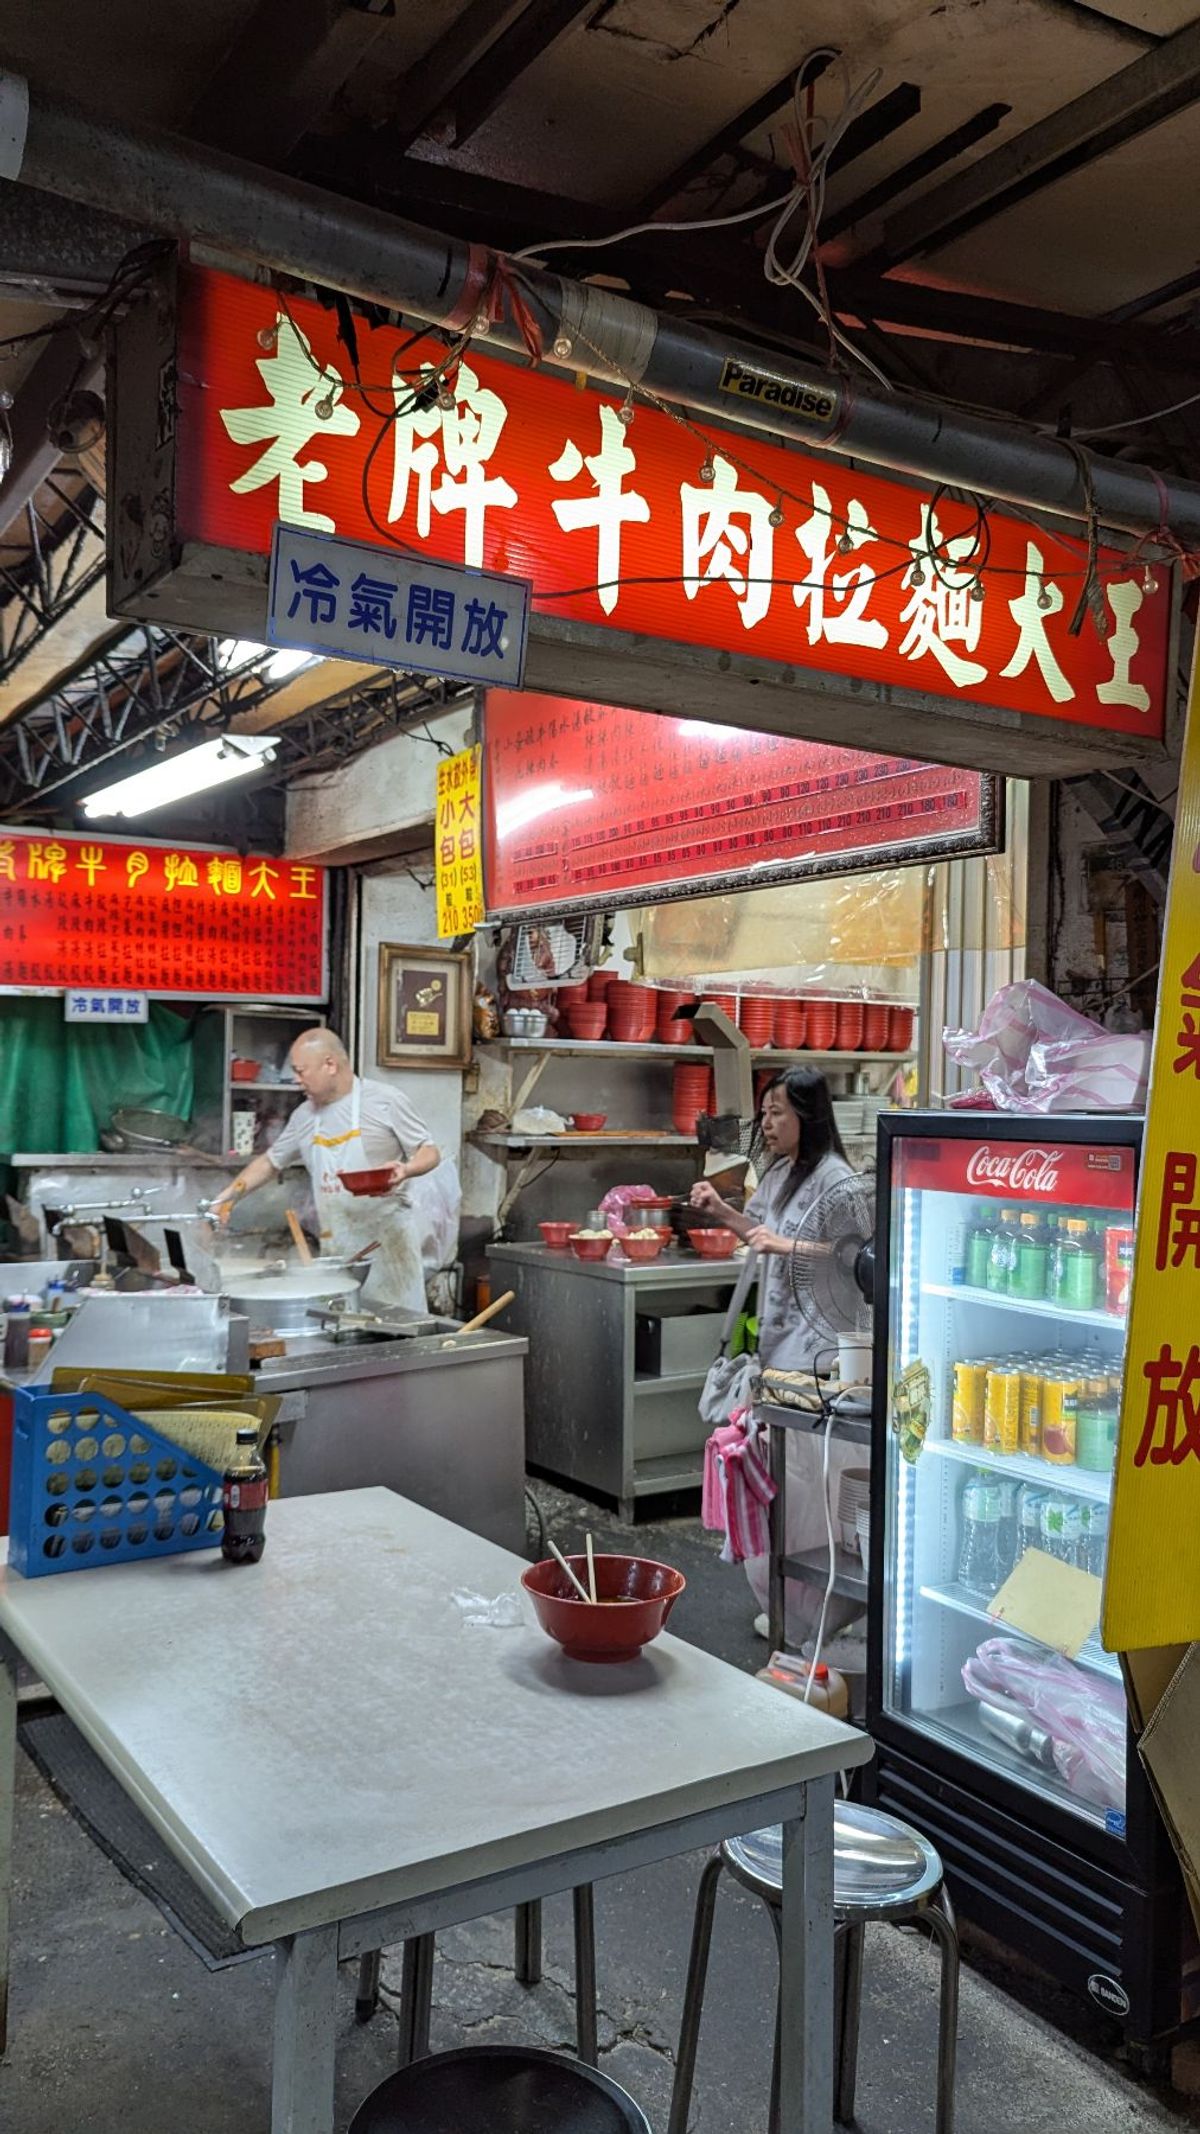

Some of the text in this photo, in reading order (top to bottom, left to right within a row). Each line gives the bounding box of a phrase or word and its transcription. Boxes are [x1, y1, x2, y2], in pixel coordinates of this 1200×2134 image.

[722, 361, 836, 418] Paradise
[219, 312, 1152, 713] 老牌牛肉拉麵大王
[287, 558, 510, 660] 冷氣開放
[72, 996, 141, 1013] 冷氣開放
[966, 1145, 1063, 1192] Coca-Cola
[1134, 840, 1200, 1468] 開放
